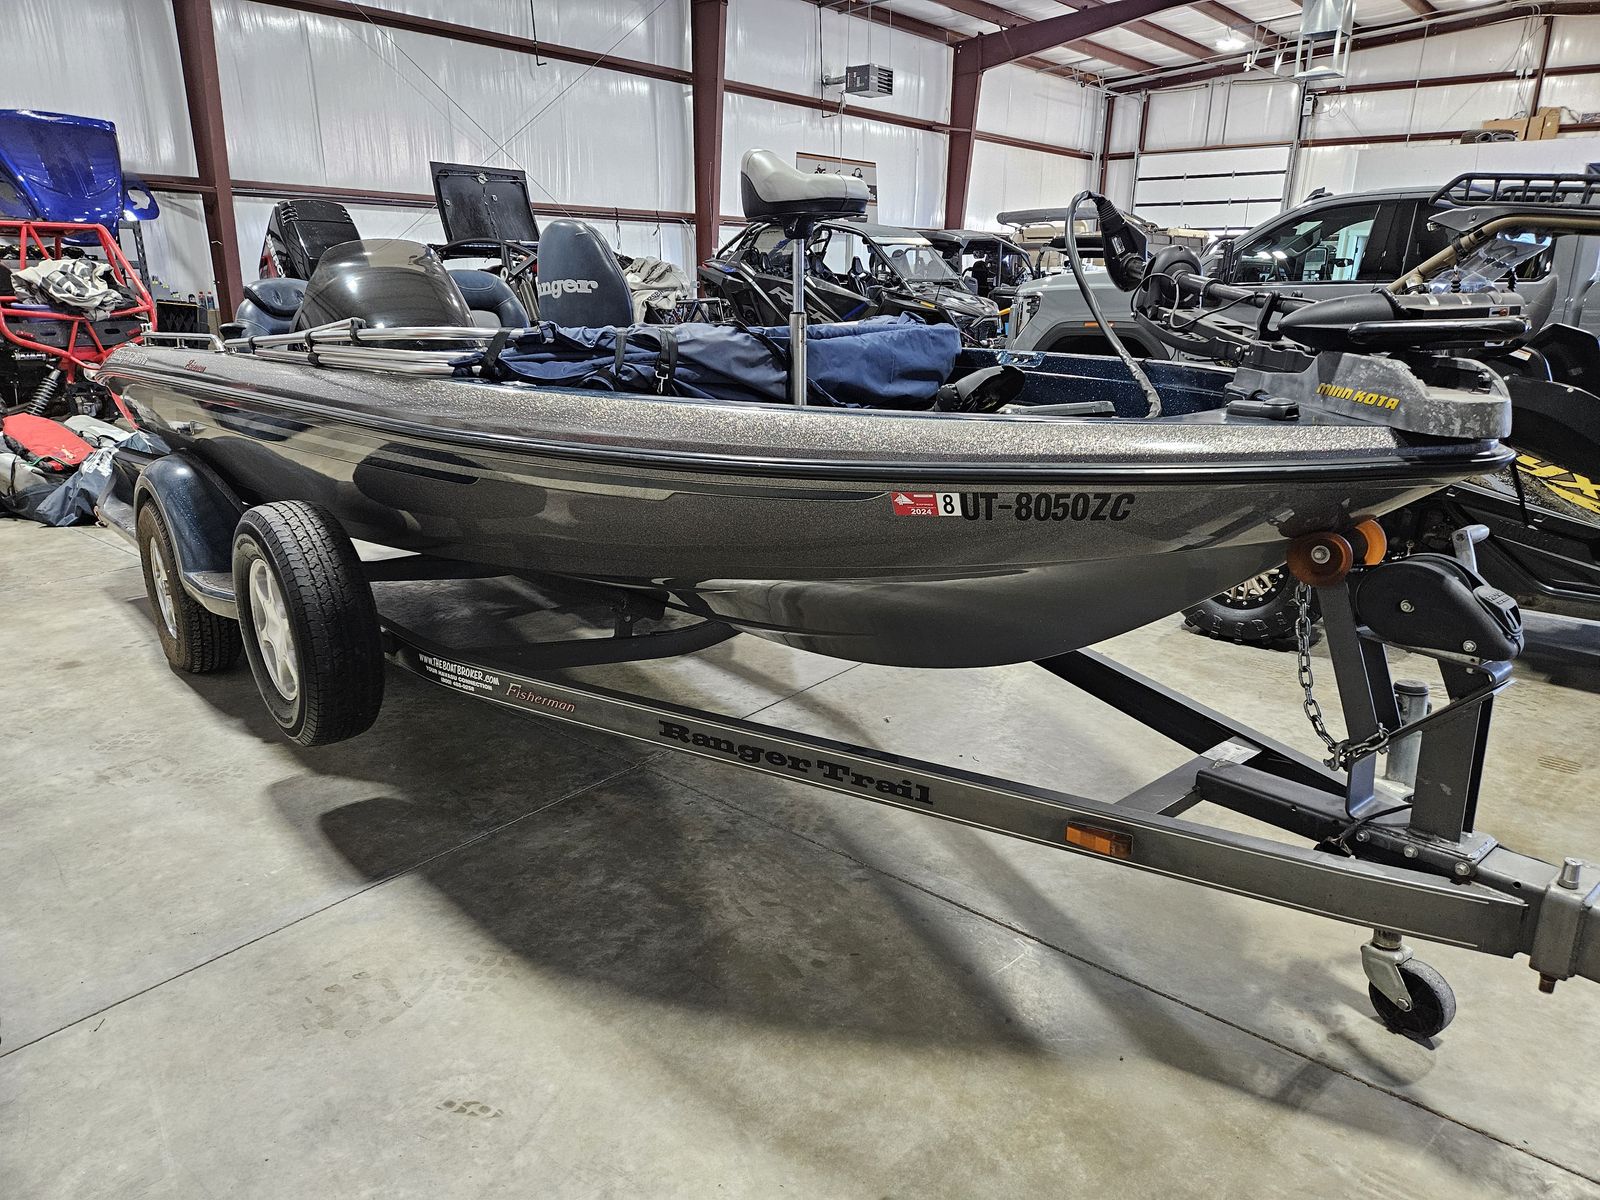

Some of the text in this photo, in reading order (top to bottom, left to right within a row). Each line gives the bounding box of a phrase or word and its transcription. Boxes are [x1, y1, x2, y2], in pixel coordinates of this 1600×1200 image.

[1352, 390, 1400, 411] KOTA
[911, 508, 932, 516] 2024
[942, 494, 955, 515] 8
[506, 682, 576, 713] Fisherman
[659, 719, 934, 805] Ranger Trail
